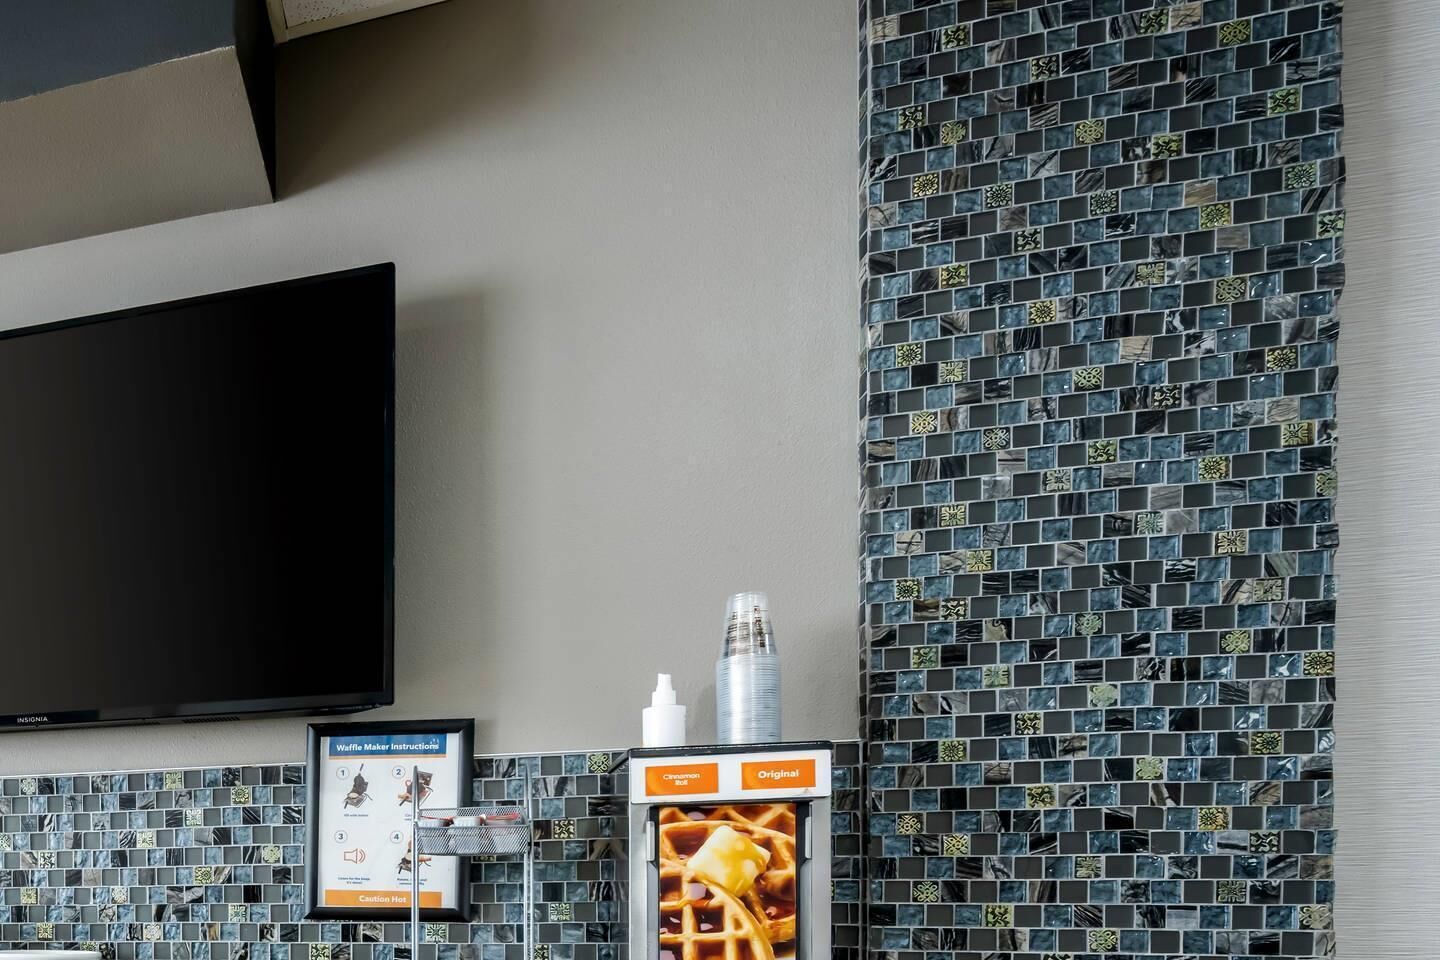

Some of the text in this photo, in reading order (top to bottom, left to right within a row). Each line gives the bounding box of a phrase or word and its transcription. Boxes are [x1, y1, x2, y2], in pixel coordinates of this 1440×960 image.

[336, 742, 440, 752] Waffle Maker Instructions
[757, 769, 800, 780] Original
[359, 895, 407, 904] Caution Hot
